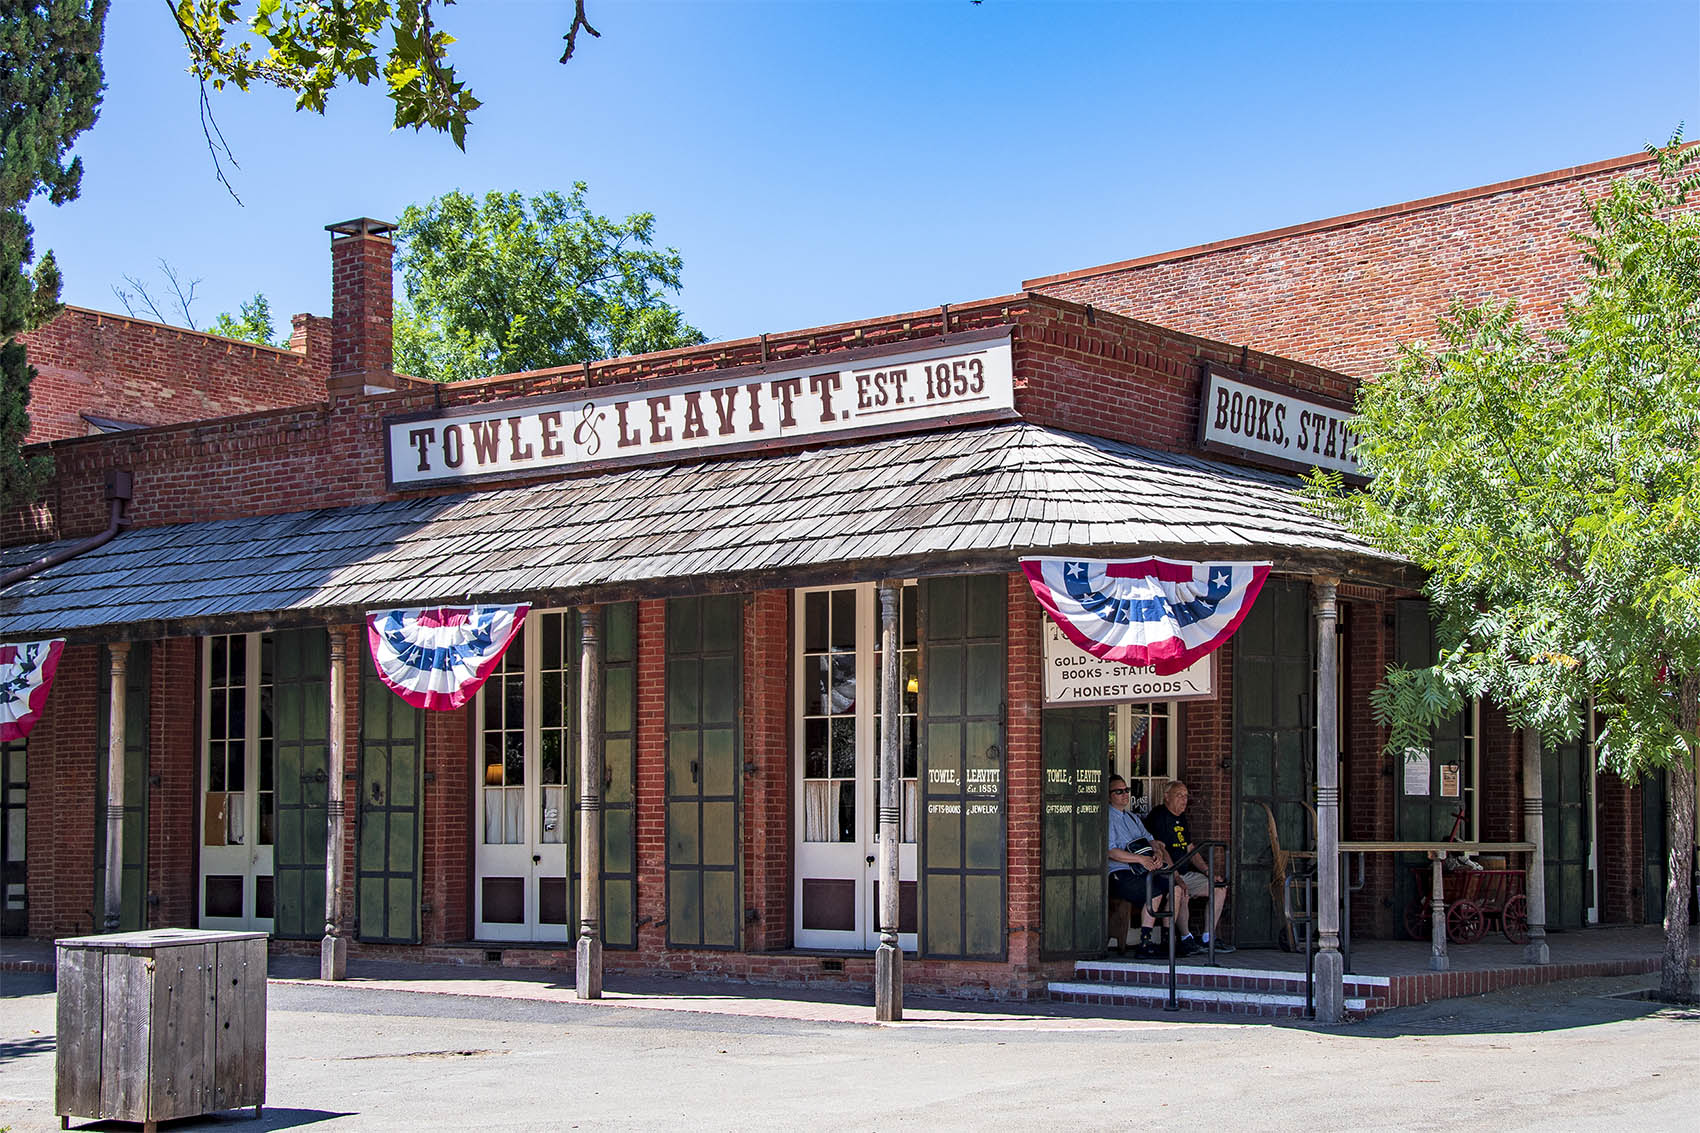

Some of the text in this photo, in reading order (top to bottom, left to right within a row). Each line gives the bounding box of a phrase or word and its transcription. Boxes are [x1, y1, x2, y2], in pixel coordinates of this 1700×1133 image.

[409, 358, 985, 472] TOWLE & LEAVITT. EST. 1853
[1214, 386, 1290, 449] BOOKS,
[1054, 656, 1087, 667] GOLD
[1062, 668, 1102, 680] BOOKS
[1073, 681, 1181, 698] HONEST GOODS
[928, 769, 955, 783] TOWLE
[966, 769, 1000, 783] LEAVITT
[1046, 769, 1067, 783] TOWLE
[1076, 769, 1102, 783] LEAVITT
[979, 784, 998, 793] 1853
[970, 805, 998, 814] JEWELRY
